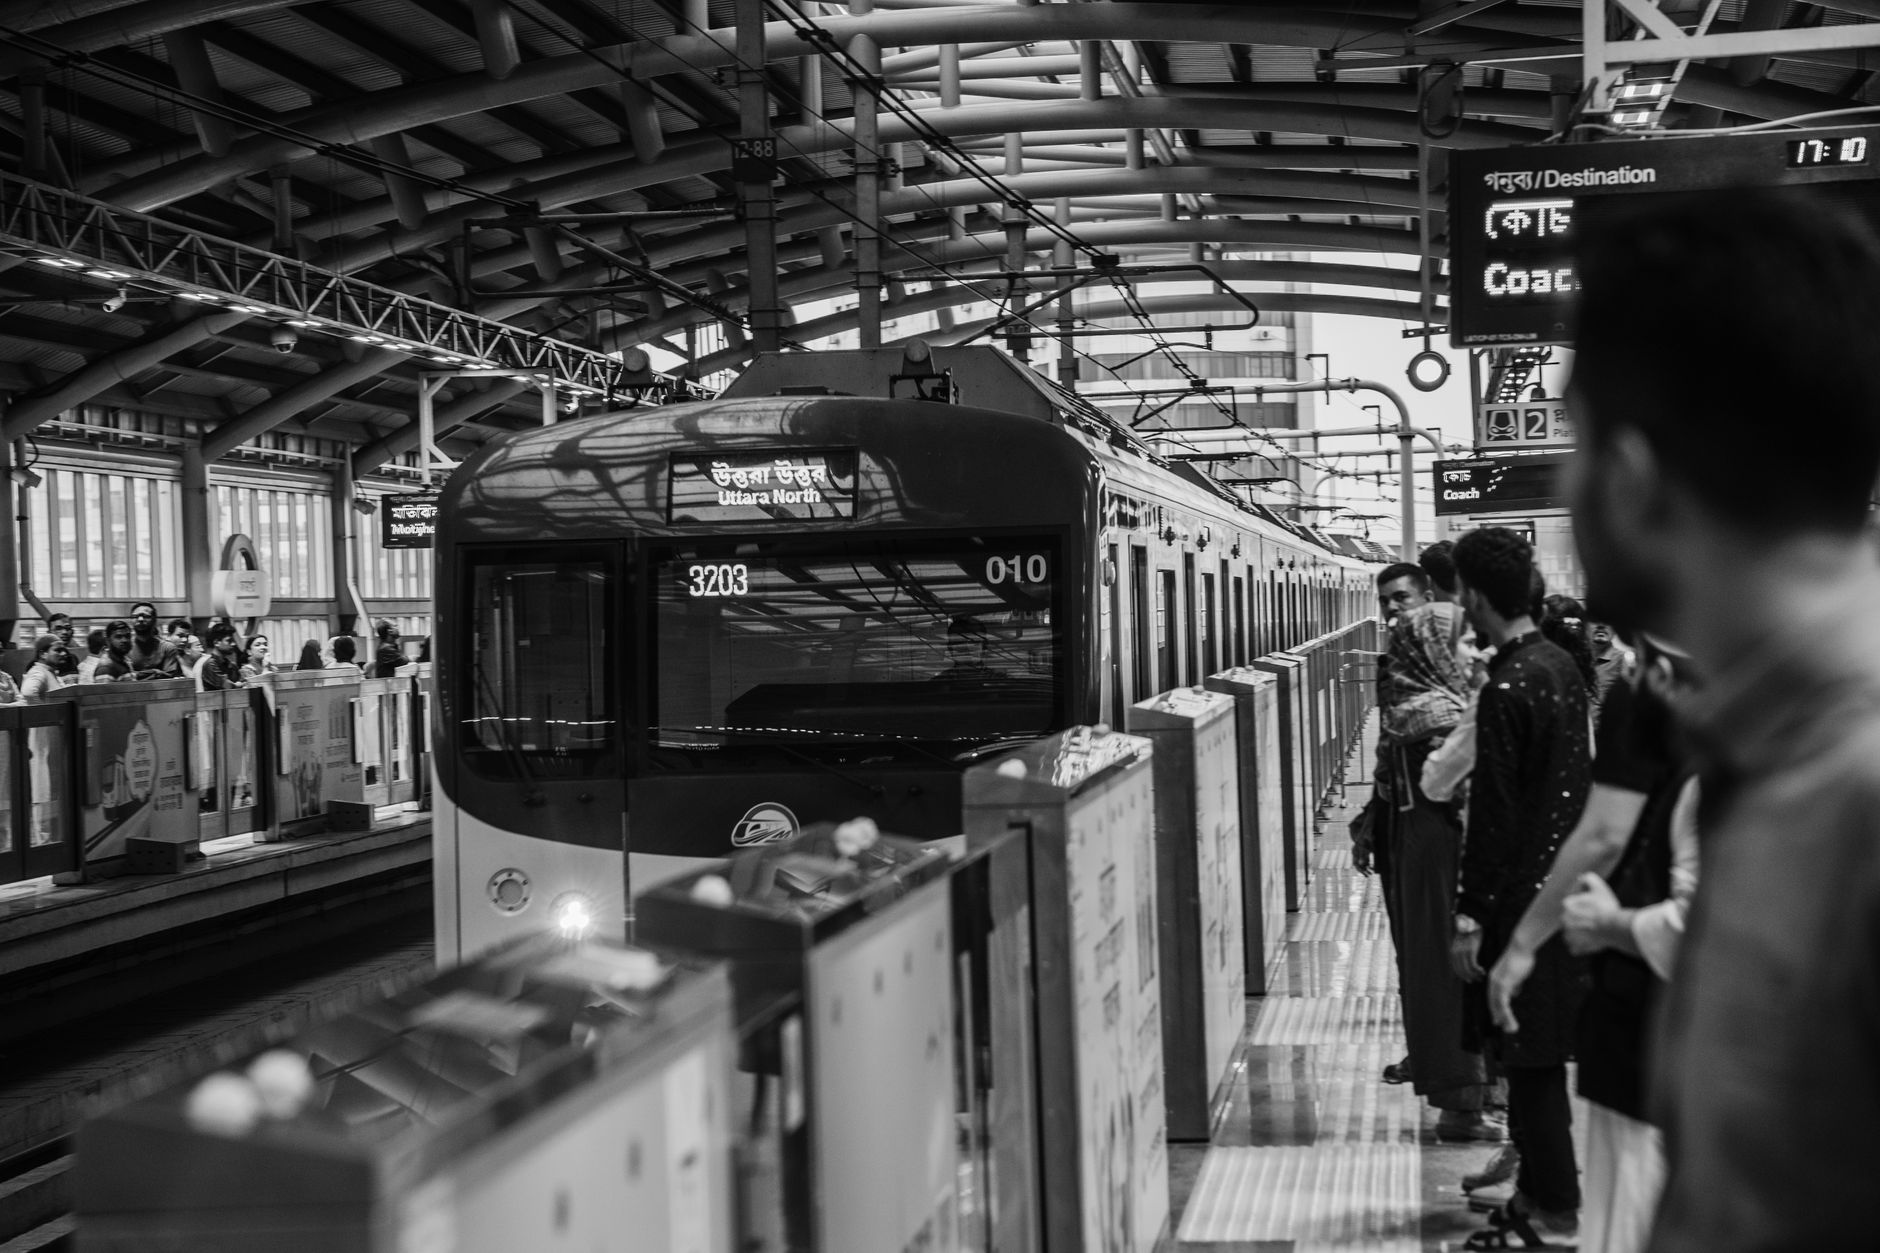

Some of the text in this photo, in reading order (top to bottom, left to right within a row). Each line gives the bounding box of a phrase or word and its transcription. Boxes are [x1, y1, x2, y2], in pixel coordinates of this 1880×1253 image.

[1484, 262, 1582, 295] Coac
[1526, 411, 1546, 437] 2
[711, 459, 827, 488] উত্তরা উত্তর
[718, 488, 821, 506] Uttara North
[1443, 487, 1480, 500] Coach
[689, 564, 748, 597] 3203
[985, 554, 1047, 585] 010
